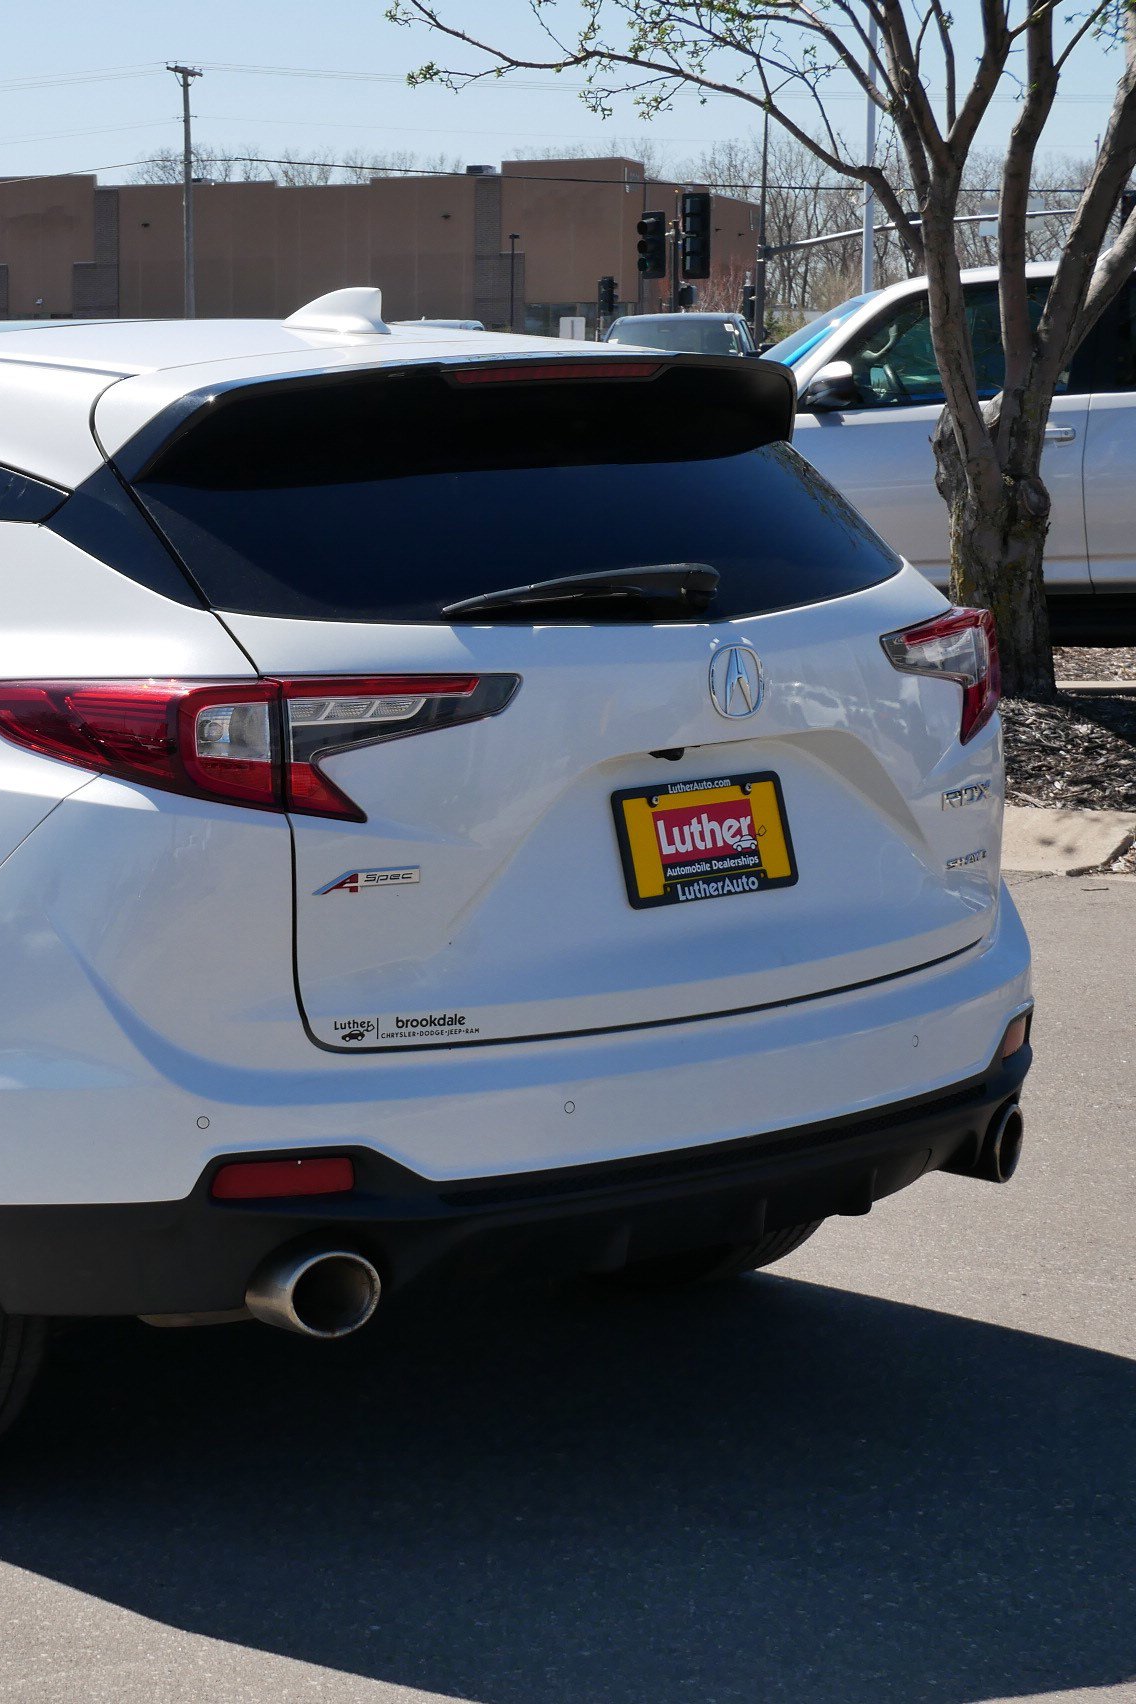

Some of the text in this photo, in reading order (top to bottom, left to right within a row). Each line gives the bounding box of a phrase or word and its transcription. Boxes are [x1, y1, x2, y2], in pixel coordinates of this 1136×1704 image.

[668, 778, 731, 794] LutherAuto.com
[941, 779, 991, 811] RDX
[656, 812, 751, 855] Luther
[666, 855, 759, 877] Automobile Dealerships
[677, 875, 759, 901] LutherAuto
[334, 1014, 466, 1031] Luther brookdale
